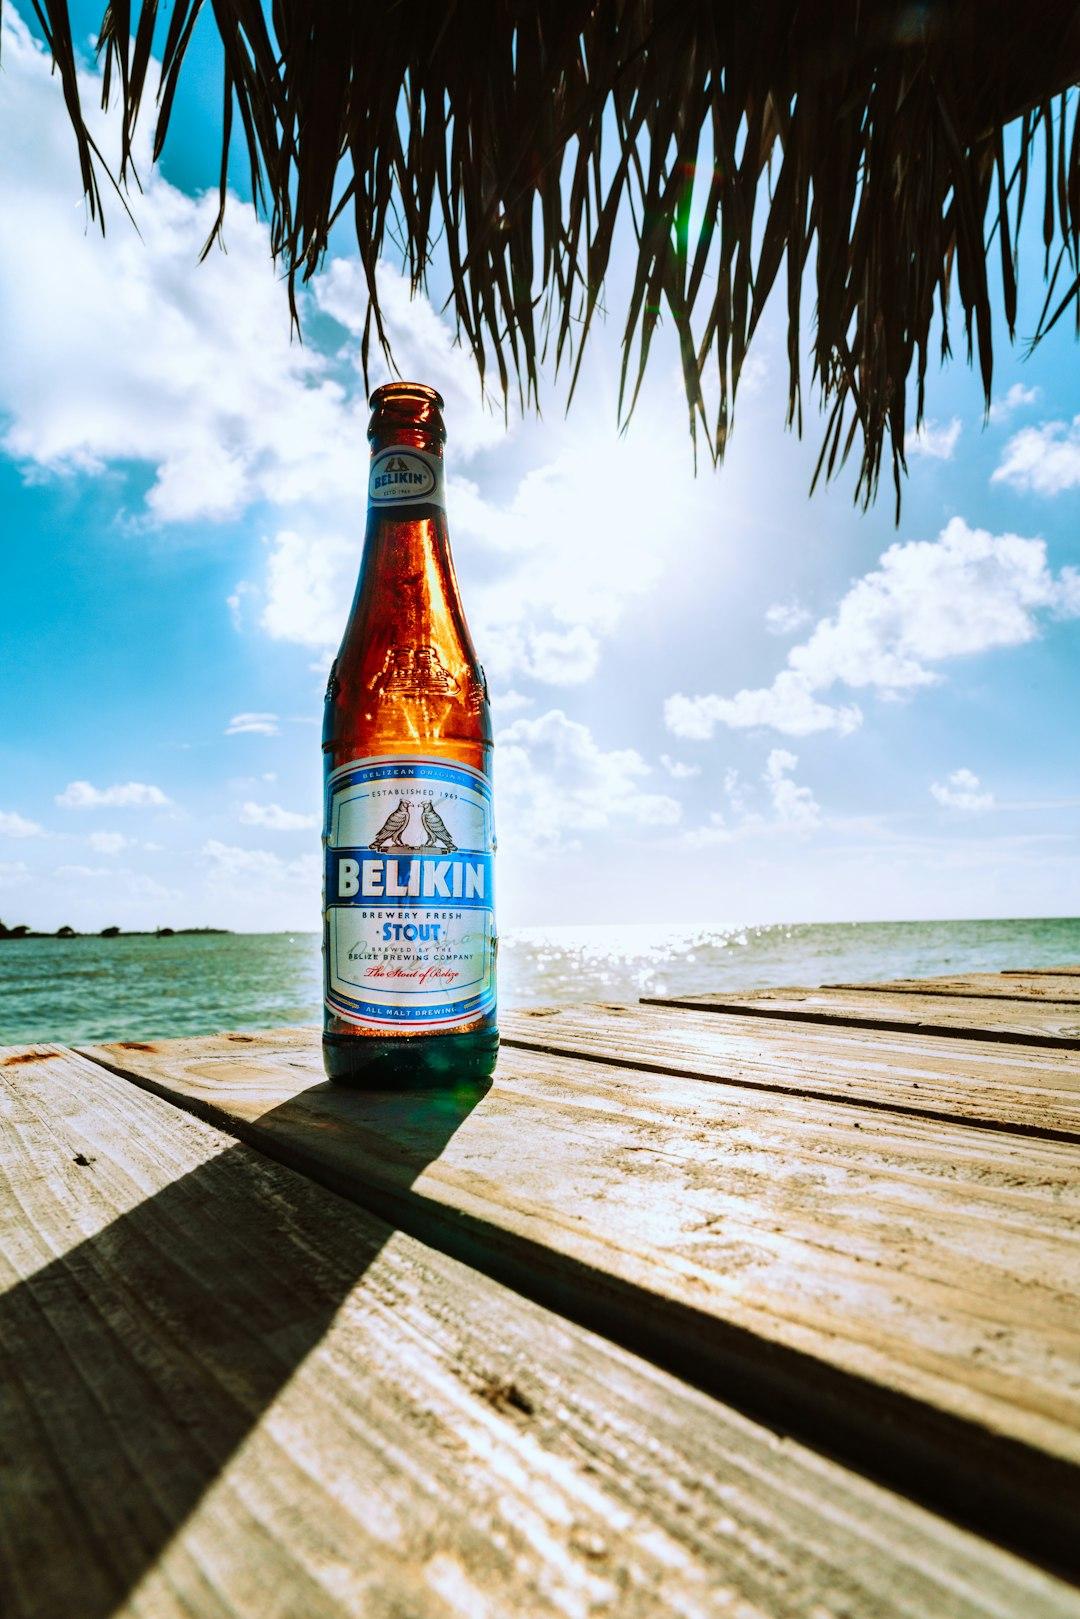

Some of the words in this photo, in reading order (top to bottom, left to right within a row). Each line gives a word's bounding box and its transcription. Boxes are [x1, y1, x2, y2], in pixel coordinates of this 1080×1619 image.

[374, 472, 423, 489] BELIKIN
[362, 769, 414, 779] BELIZEAN
[371, 788, 434, 798] ESTABLISHED
[440, 791, 458, 800] 1969
[338, 858, 485, 899] BELIKIN
[362, 911, 418, 919] BREWERY
[426, 912, 462, 920] FRESH
[382, 922, 441, 941] STOUT
[363, 965, 385, 978] The
[386, 966, 418, 978] Stout
[418, 965, 432, 985] of
[429, 968, 460, 983] Belize
[386, 1009, 411, 1017] MALT
